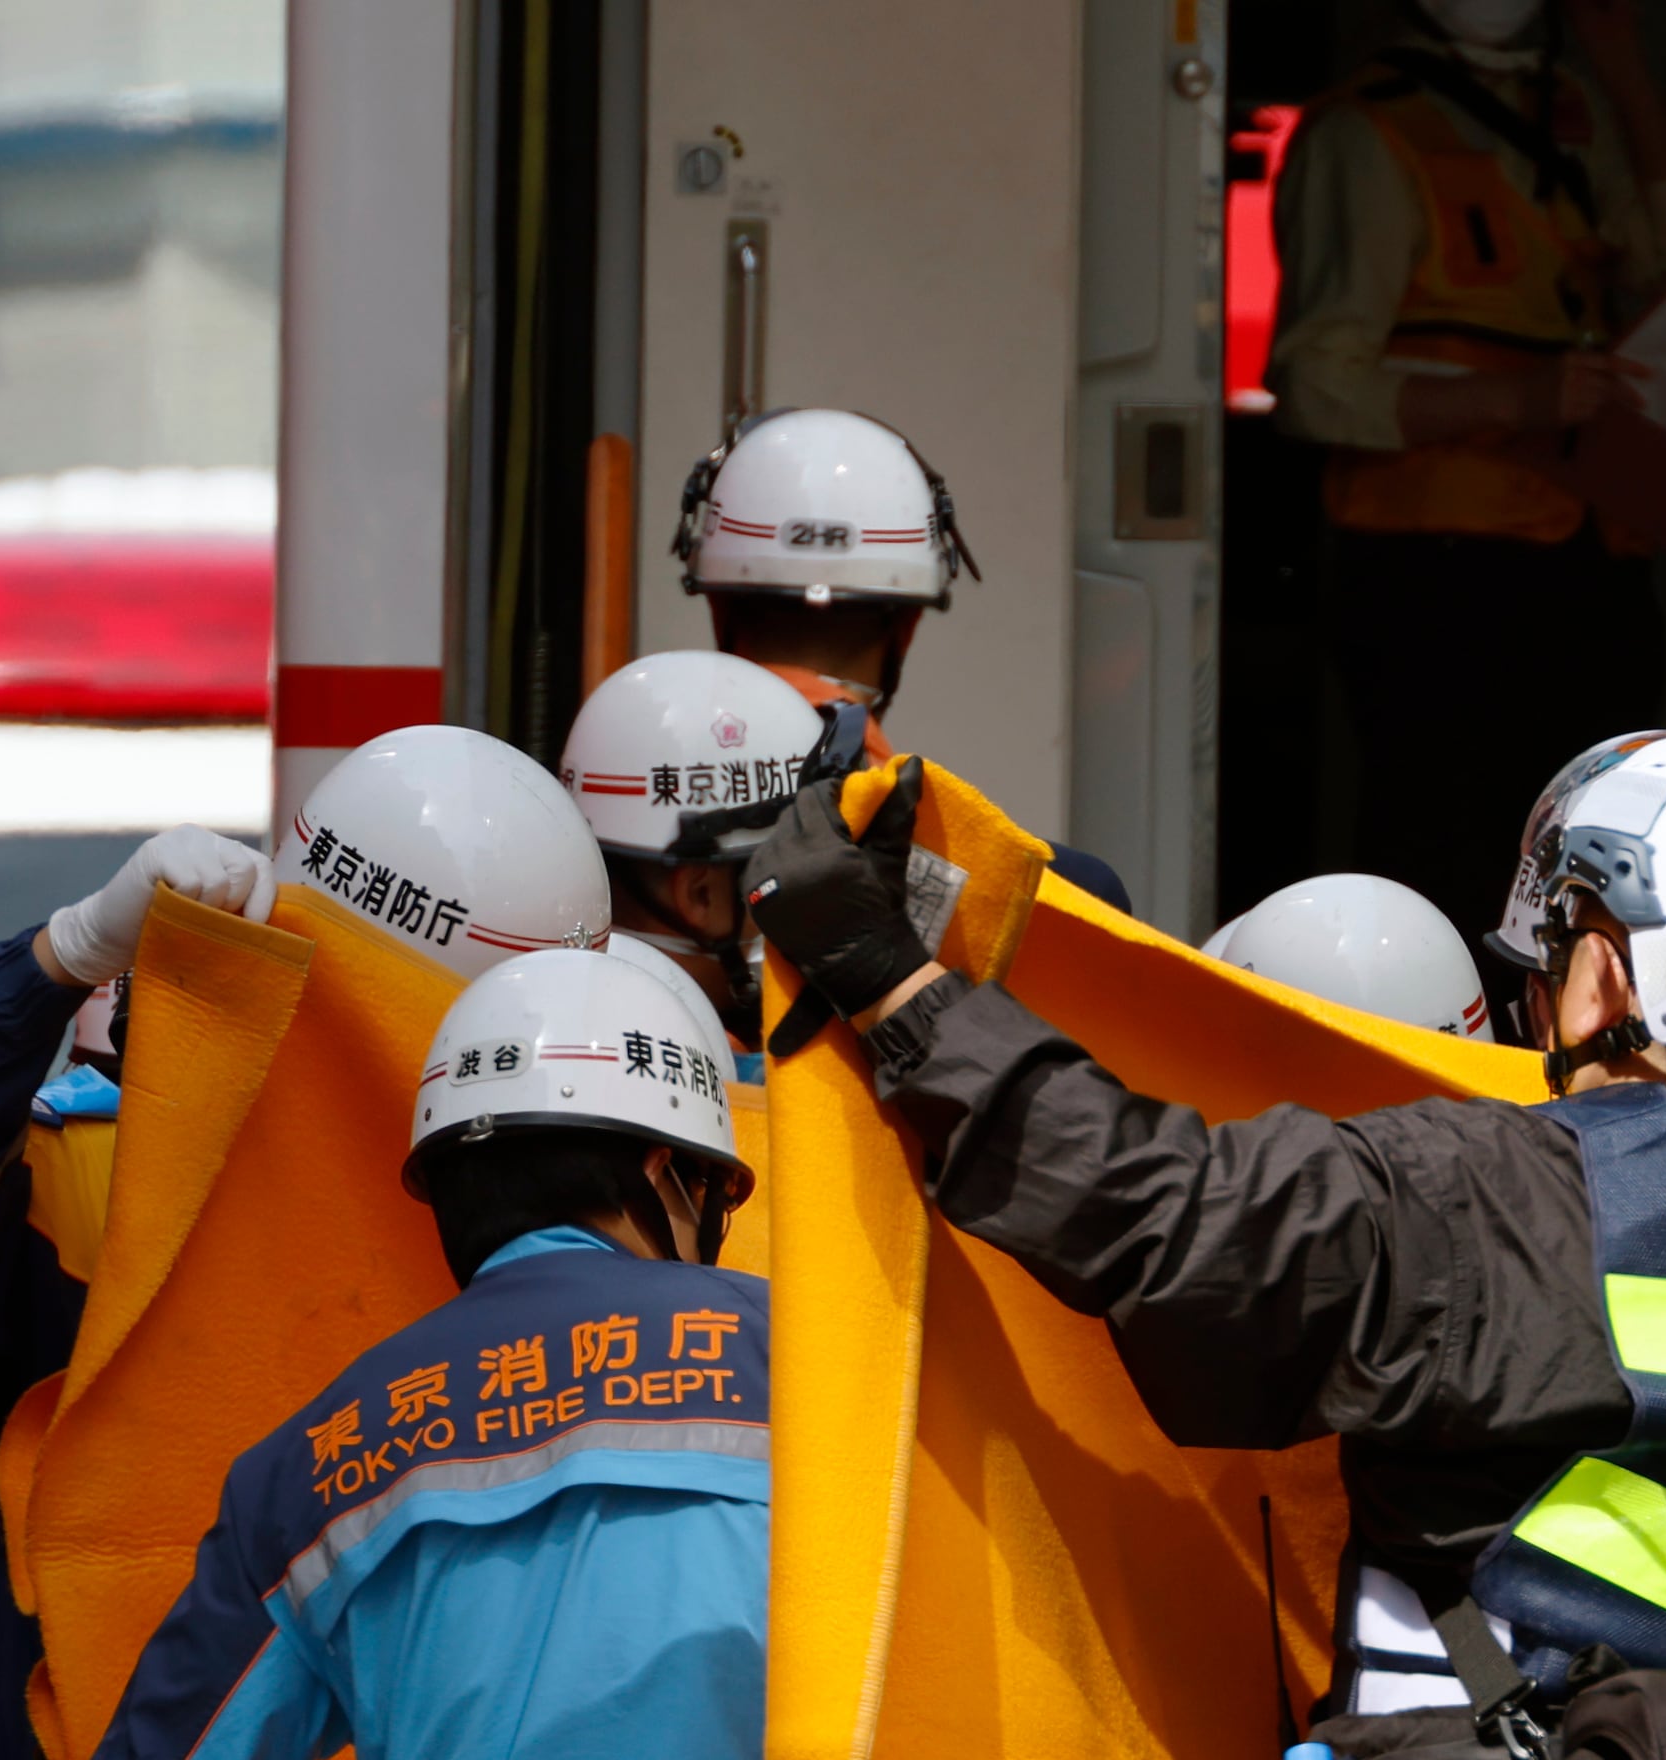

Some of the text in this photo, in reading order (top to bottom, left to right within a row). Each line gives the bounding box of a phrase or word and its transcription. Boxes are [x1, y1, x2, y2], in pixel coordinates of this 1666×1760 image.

[790, 523, 848, 548] 2HR
[301, 826, 470, 947] 東京消防庁
[456, 1044, 521, 1079] 渋谷
[306, 1309, 740, 1476] 東京消防庁
[312, 1368, 742, 1506] TOKYO FIRE DEPT.
